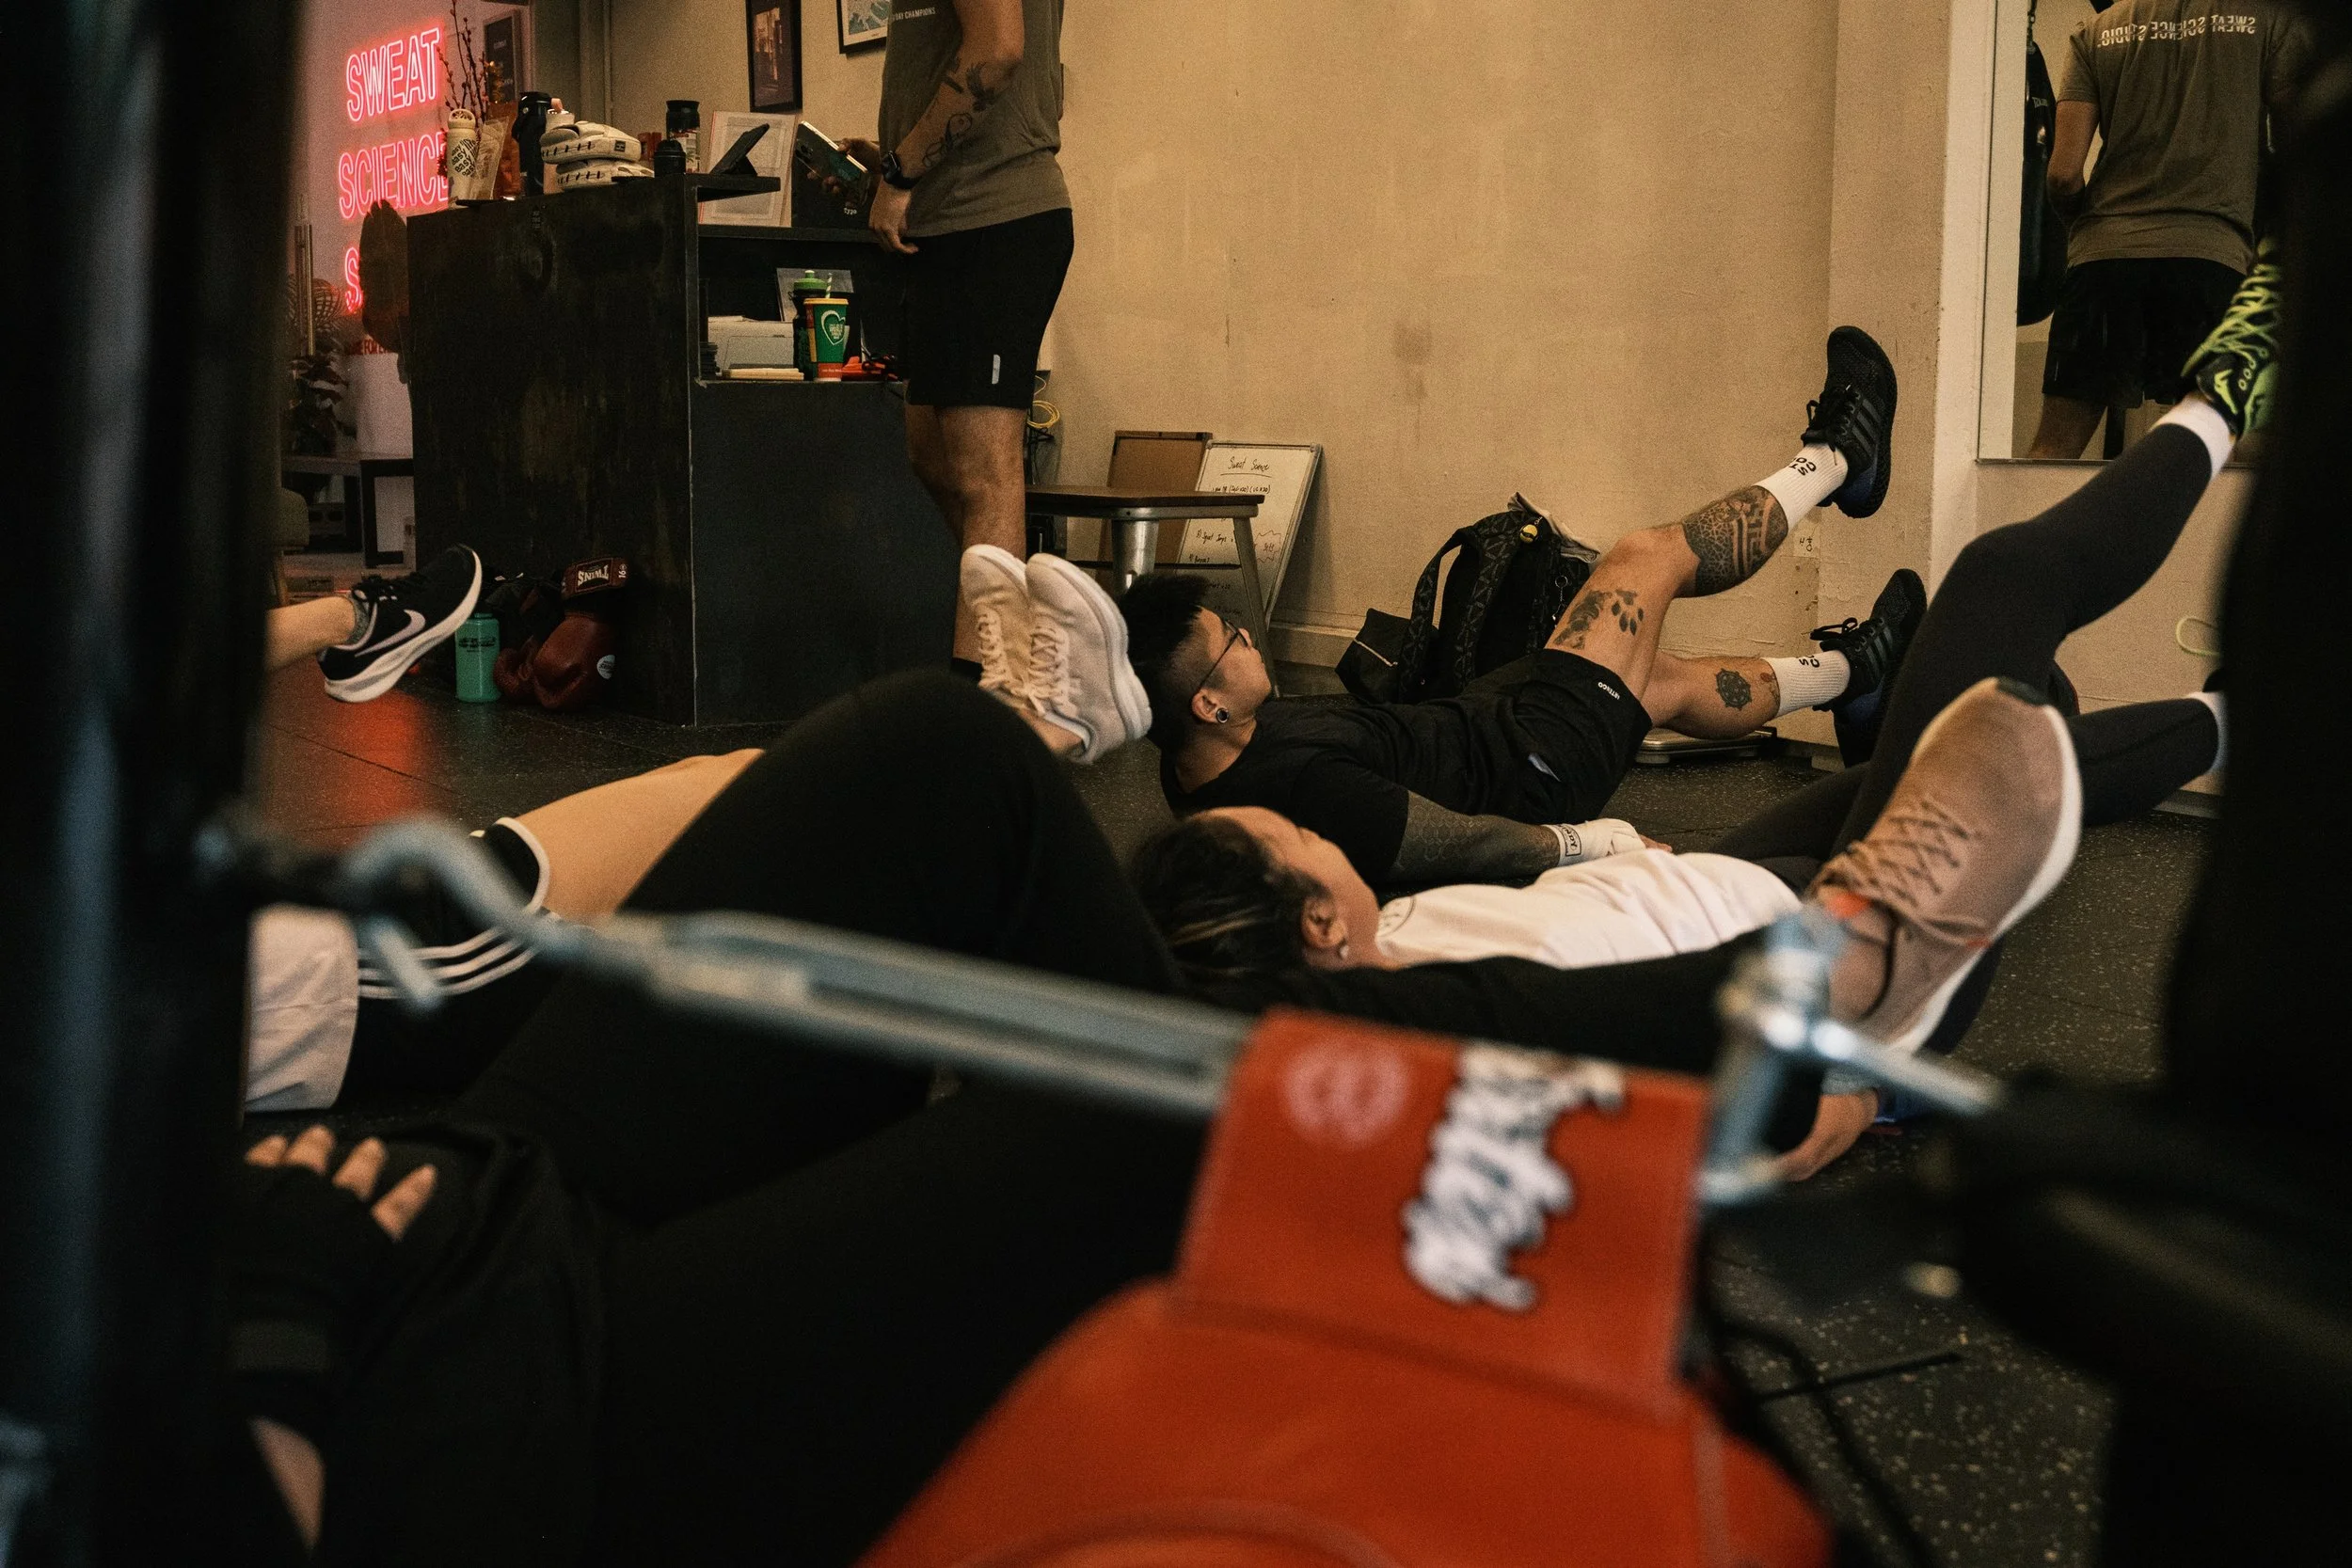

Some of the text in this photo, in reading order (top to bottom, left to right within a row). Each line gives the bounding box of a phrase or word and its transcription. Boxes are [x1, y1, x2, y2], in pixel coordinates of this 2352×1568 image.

[345, 27, 440, 122] SWEAT
[339, 130, 449, 220] SCIENCE
[577, 564, 609, 587] TWINS
